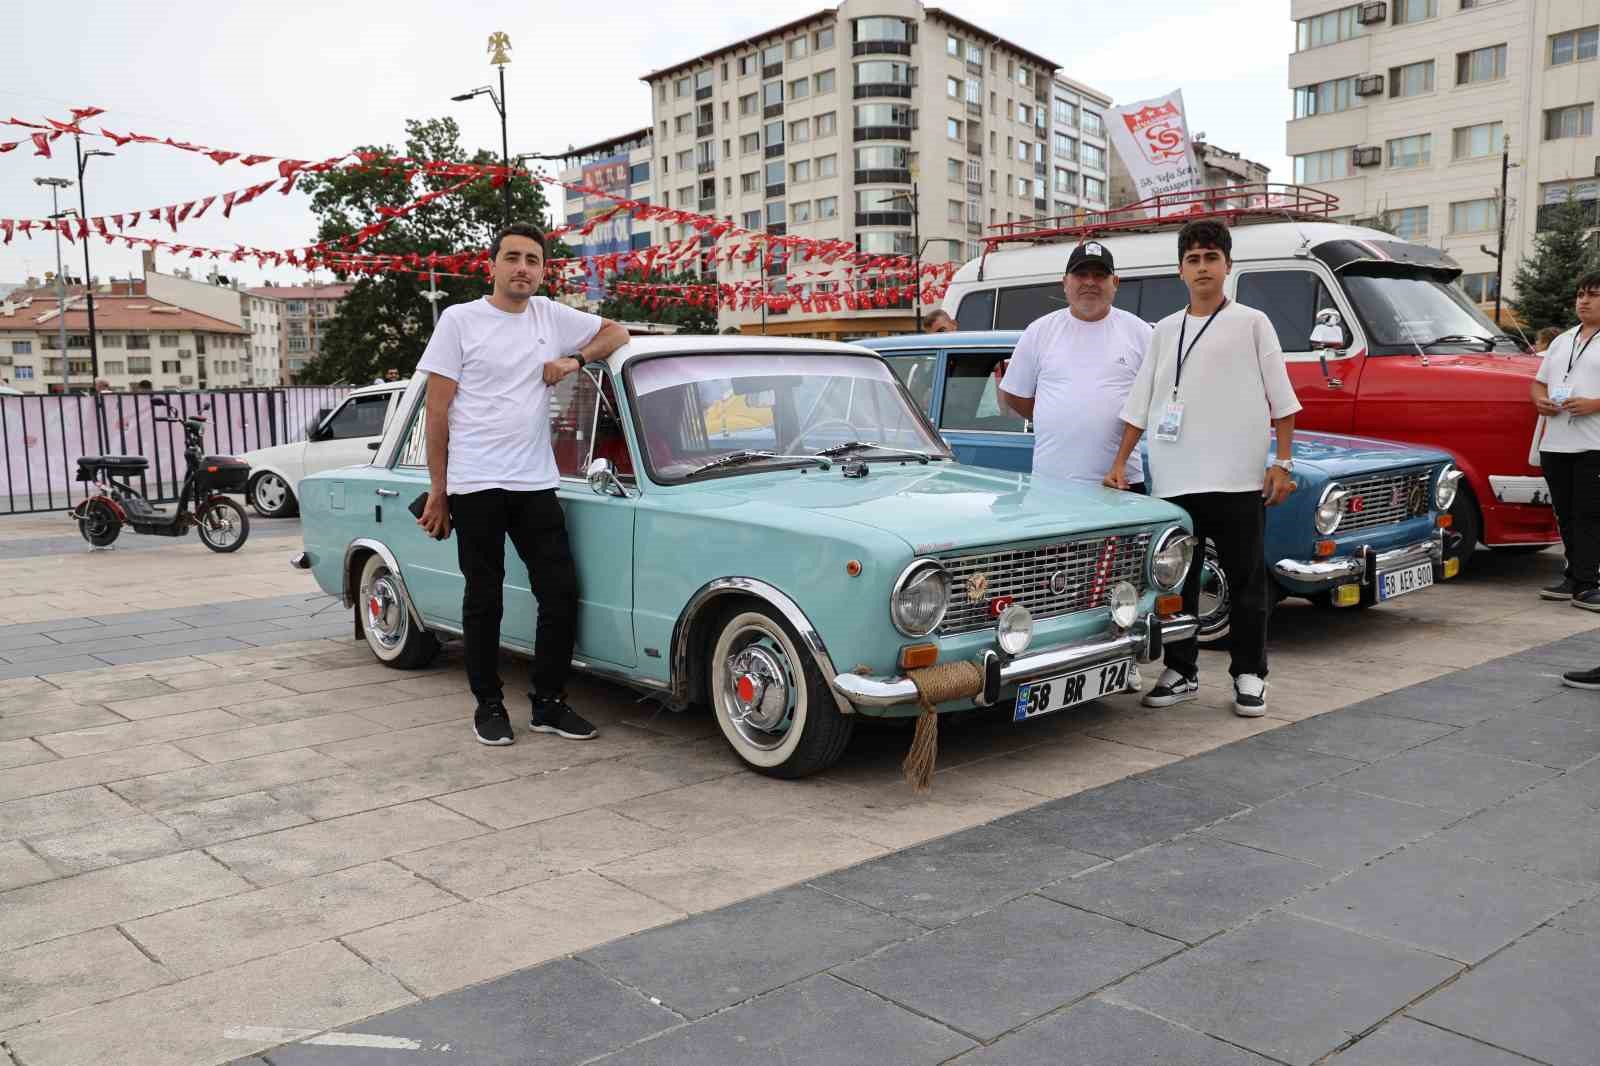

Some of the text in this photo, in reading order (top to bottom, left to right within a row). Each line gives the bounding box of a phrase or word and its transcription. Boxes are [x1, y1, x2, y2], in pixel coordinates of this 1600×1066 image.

[1385, 565, 1432, 595] 58 AER 900
[1027, 662, 1128, 714] 58 BR 124
